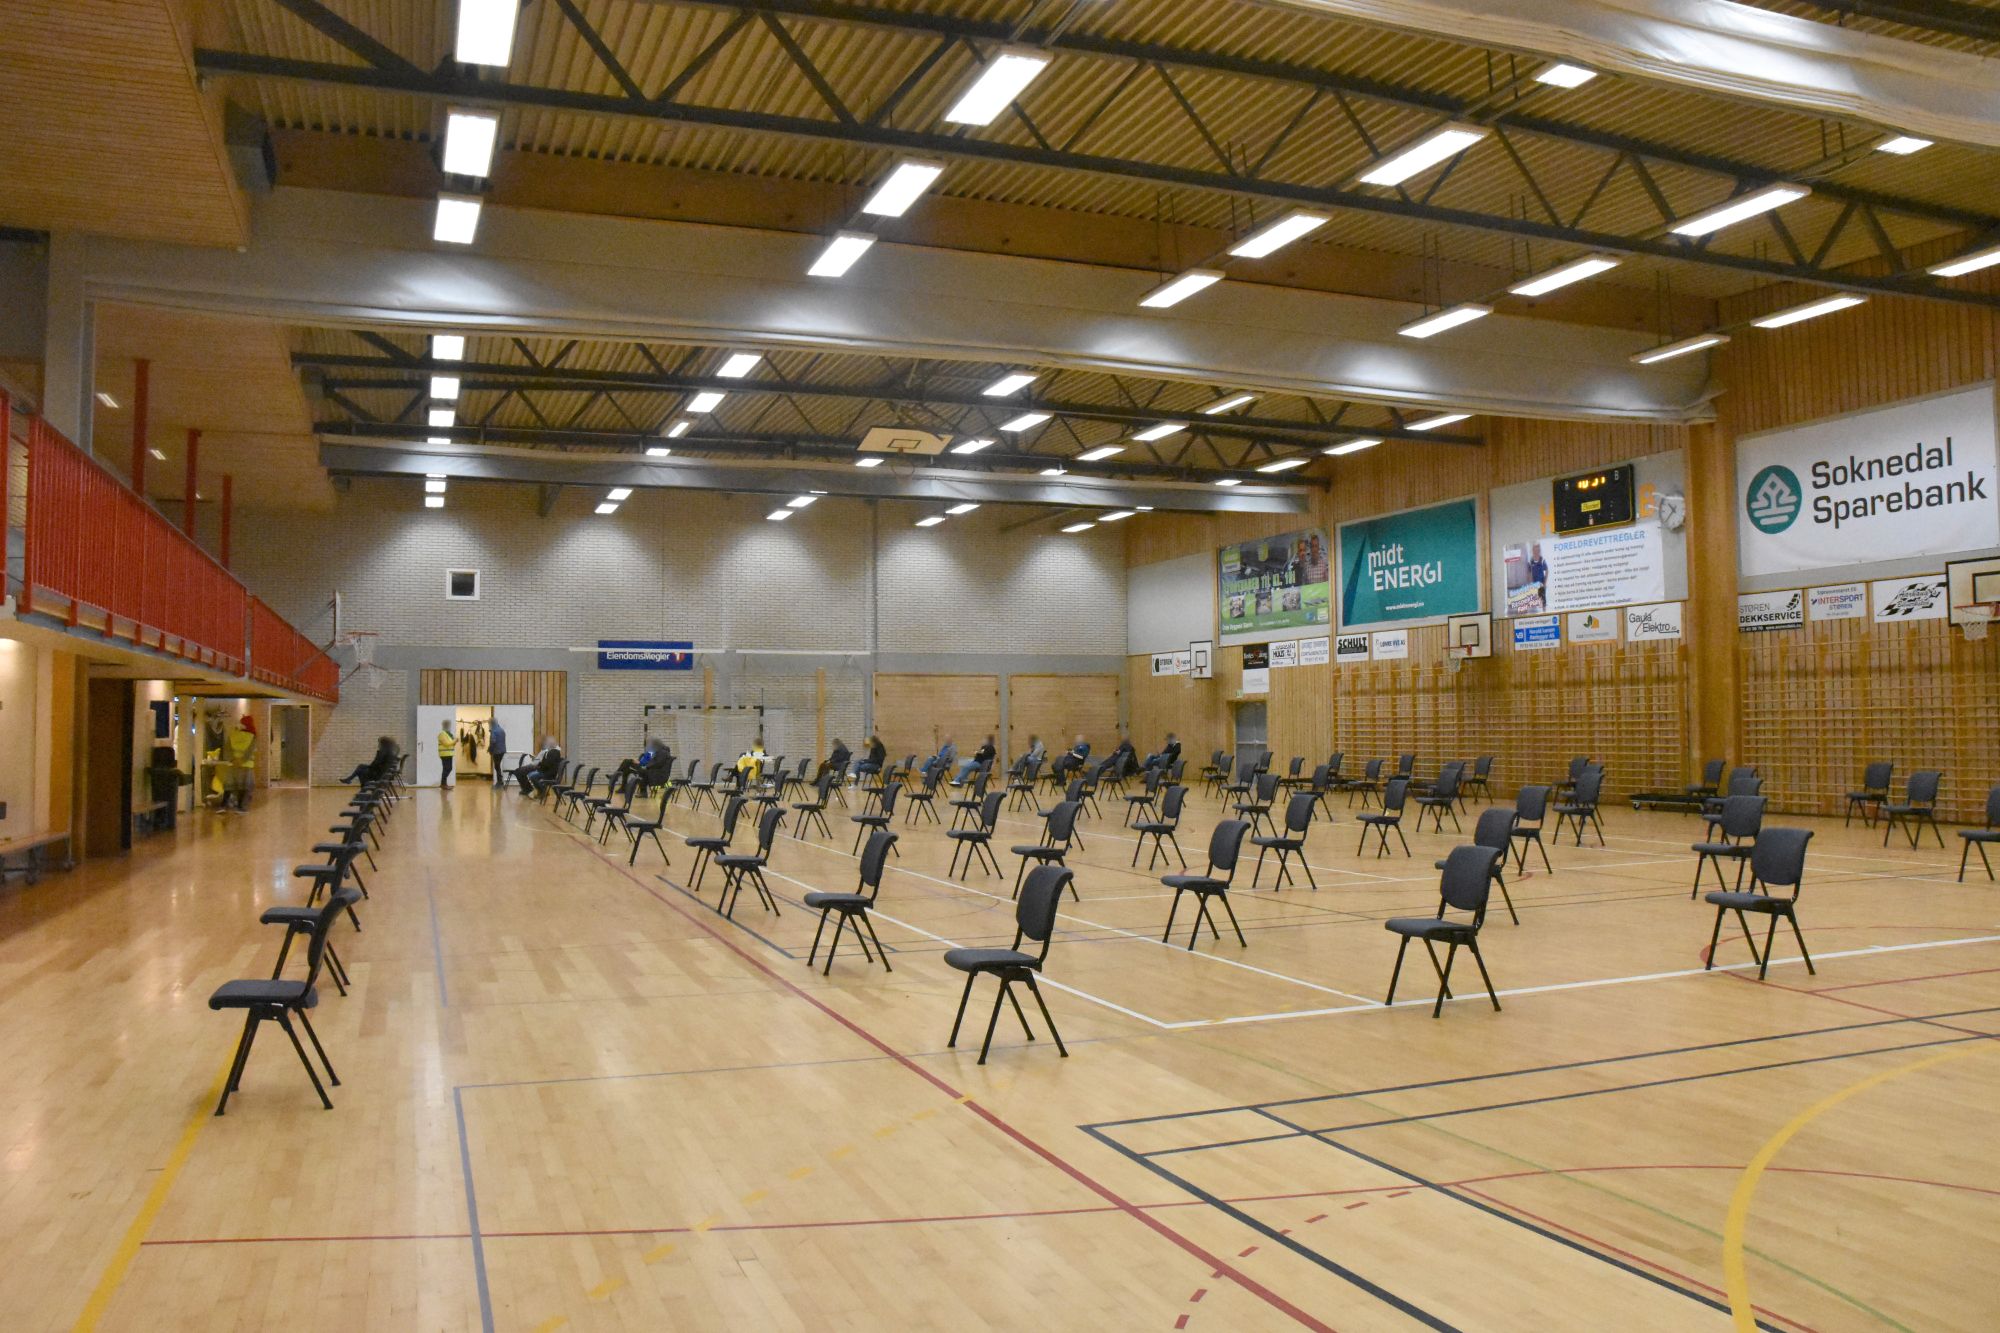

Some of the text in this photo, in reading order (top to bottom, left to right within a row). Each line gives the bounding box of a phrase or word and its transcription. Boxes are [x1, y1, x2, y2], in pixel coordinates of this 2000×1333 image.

[1811, 437, 1952, 489] Soknedal
[1813, 471, 1987, 529] Sparebank
[1554, 531, 1645, 551] FORELDREVETTREGLER
[1368, 543, 1404, 576] midt
[1373, 560, 1442, 591] ENERGI
[1818, 594, 1863, 604] INTERSPORT
[1739, 603, 1770, 614] STØREN
[1629, 612, 1652, 623] Gaula
[1740, 611, 1801, 623] DEKKSERVICE
[1643, 622, 1670, 633] Elektro
[1338, 637, 1367, 649] SCHULT
